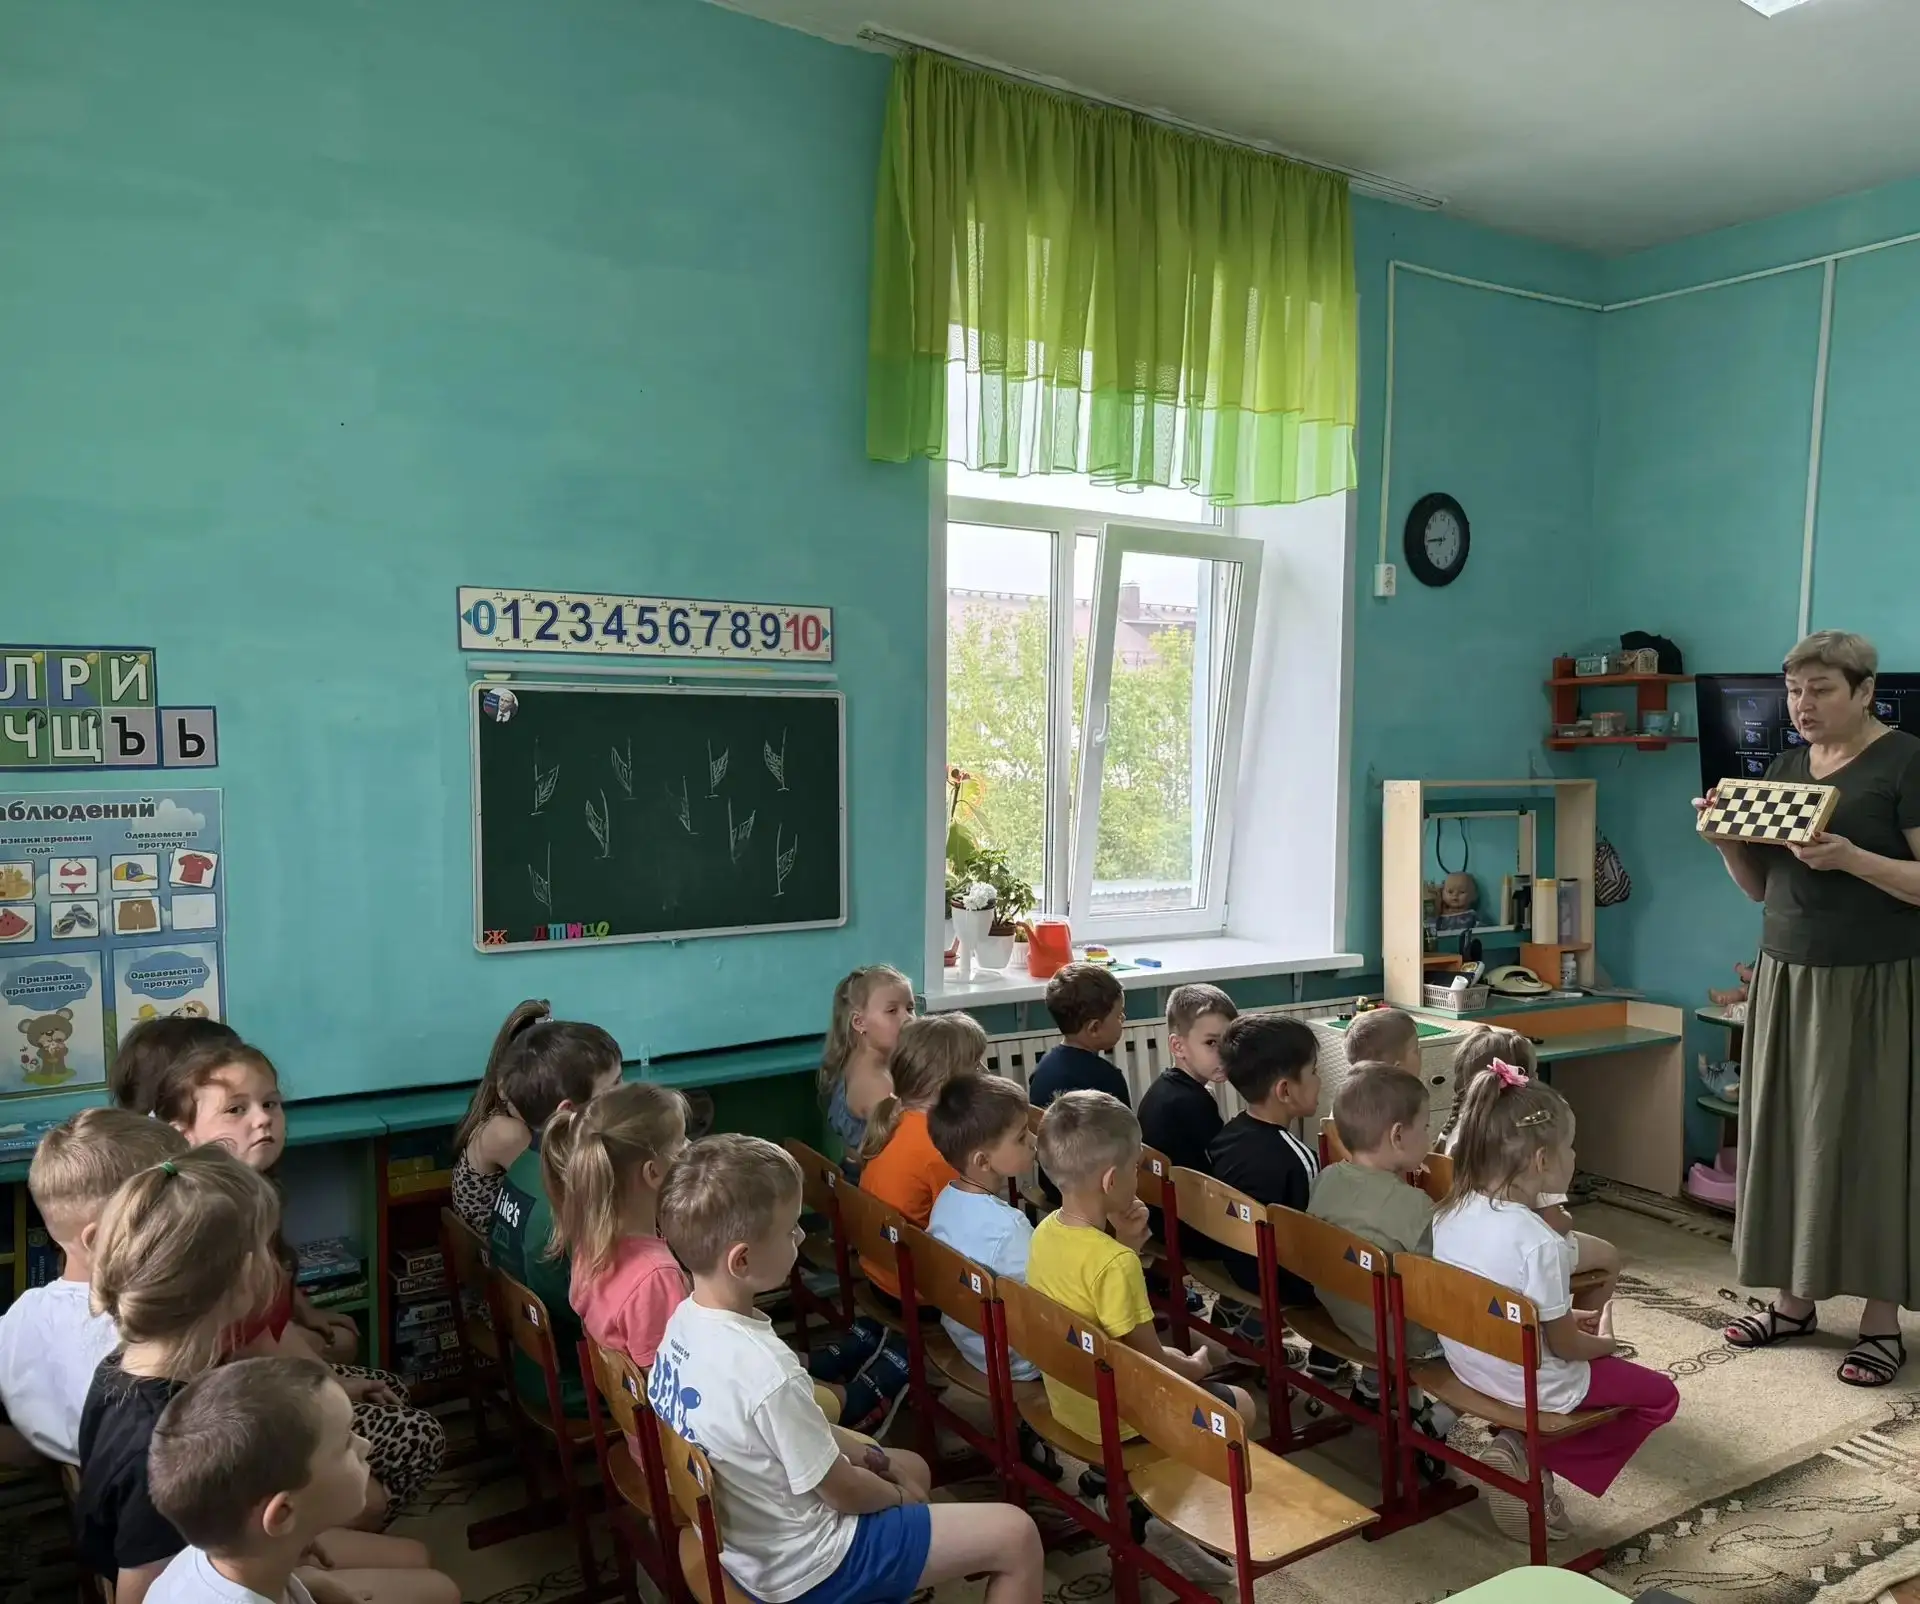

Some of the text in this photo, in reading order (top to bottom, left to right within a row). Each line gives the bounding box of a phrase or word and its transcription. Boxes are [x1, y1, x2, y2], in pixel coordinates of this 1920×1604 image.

[472, 599, 821, 651] 0 1 2 3 4 5 6 7 8 9 10
[0, 655, 148, 701] Л Р Й
[4, 715, 205, 763] Ч Щ Ъ Ь
[43, 835, 92, 844] времени
[125, 831, 183, 839] Одеваемся
[138, 841, 186, 849] прогулку:
[18, 974, 72, 984] Признаки
[131, 968, 188, 979] Одеваемся
[143, 978, 192, 988] прогулку:
[6, 983, 85, 995] времени года:
[1242, 1208, 1248, 1219] 2
[1363, 1255, 1369, 1266] 2
[1510, 1306, 1517, 1319] 2
[1084, 1336, 1091, 1349] 2
[1214, 1418, 1222, 1432] 2
